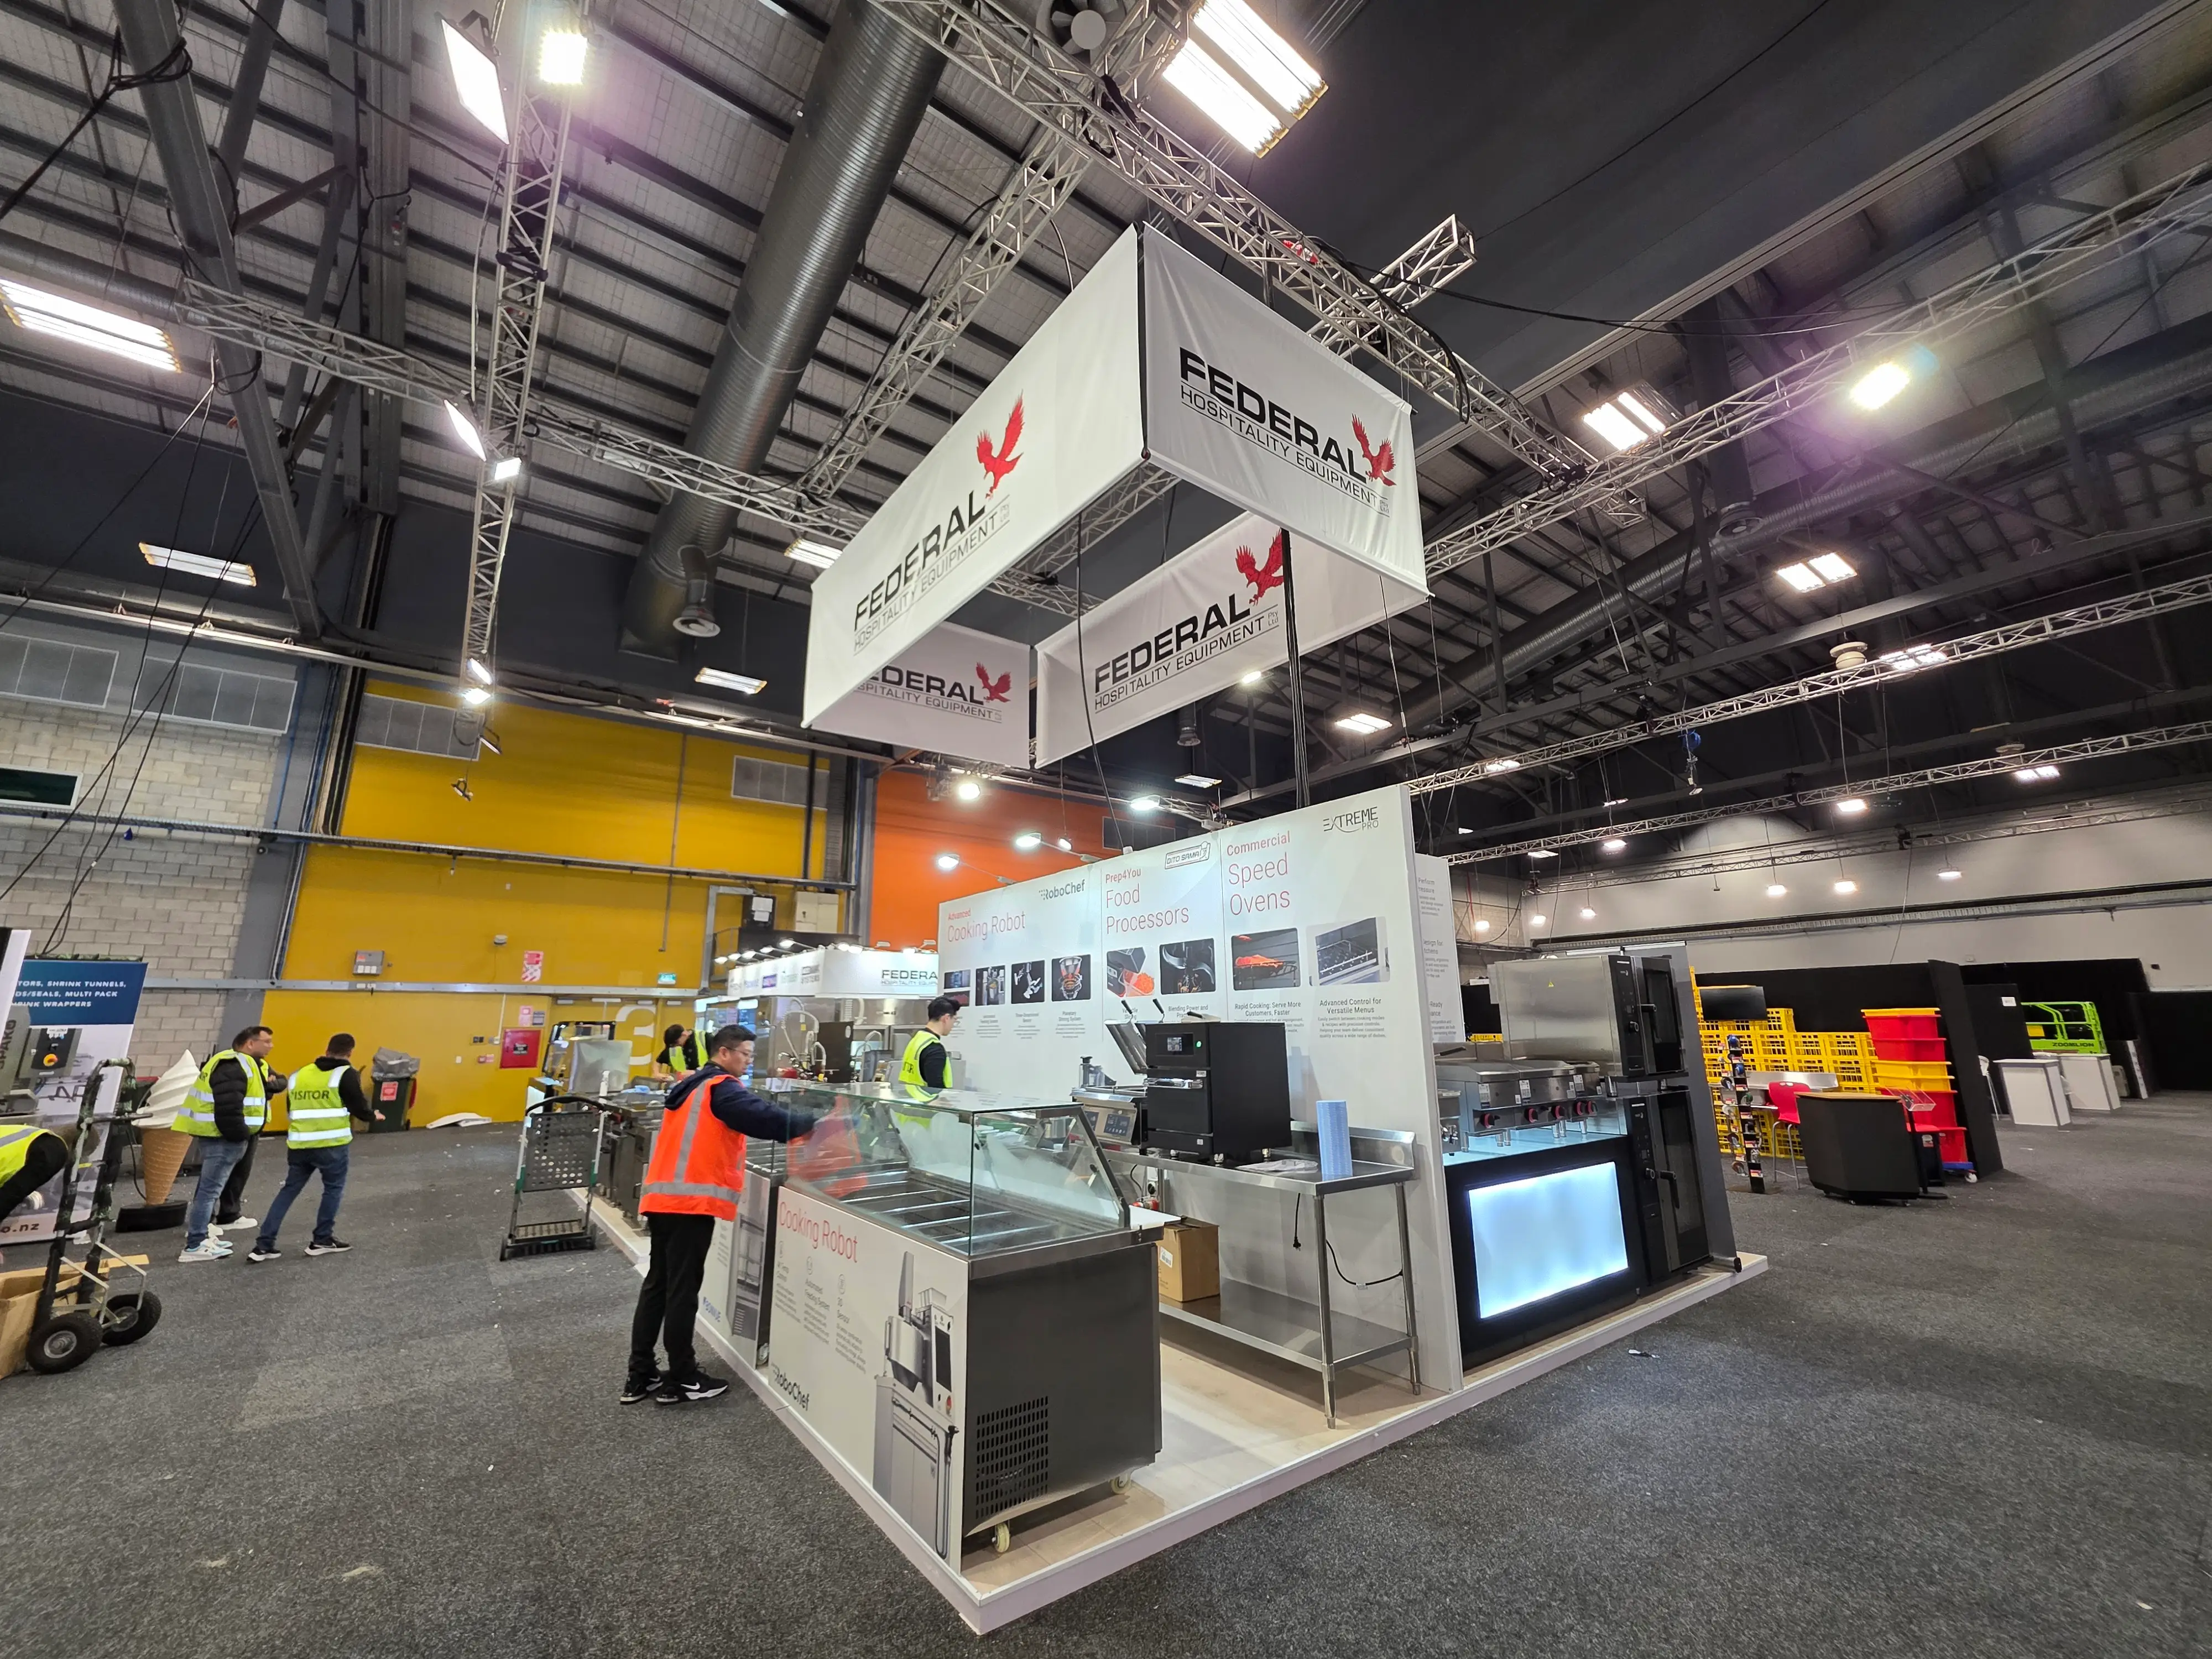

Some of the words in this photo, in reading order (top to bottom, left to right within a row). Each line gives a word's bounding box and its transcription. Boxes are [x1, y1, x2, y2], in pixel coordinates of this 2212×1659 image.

[1179, 346, 1367, 484] FEDERAL
[1181, 385, 1290, 457] HOSPITALITY
[1296, 451, 1378, 508] EQUIPMENT
[854, 490, 985, 632] FEDERAL
[854, 582, 919, 652] HOSPITALITY
[921, 511, 998, 593] EQUIPMENT
[1095, 593, 1251, 694] FEDERAL
[1095, 662, 1171, 710] HOSPITALITY
[1176, 615, 1265, 671] EQUIPMENT
[870, 665, 984, 706] DERAL
[858, 683, 921, 703] SPITALITY
[926, 696, 993, 719] EQUIPMENT
[1323, 806, 1379, 832] EXTREME
[1361, 820, 1379, 831] PRO
[1227, 830, 1290, 856] Commercial
[1167, 855, 1180, 864] DITO
[1228, 852, 1288, 889] Speed
[1039, 879, 1086, 900] RoboChef
[1105, 868, 1141, 884] Prep4You
[1106, 883, 1140, 908] Food
[1230, 890, 1290, 915] Ovens
[947, 908, 971, 921] Advanced
[947, 921, 988, 942] Cooking
[992, 911, 1026, 934] Robot
[1107, 907, 1189, 935] Processors
[881, 969, 938, 979] FEDERA
[1, 1223, 40, 1233] o.nz
[779, 1201, 819, 1249] Cooking
[822, 1220, 858, 1263] Robot
[771, 1362, 810, 1411] RoboChef
